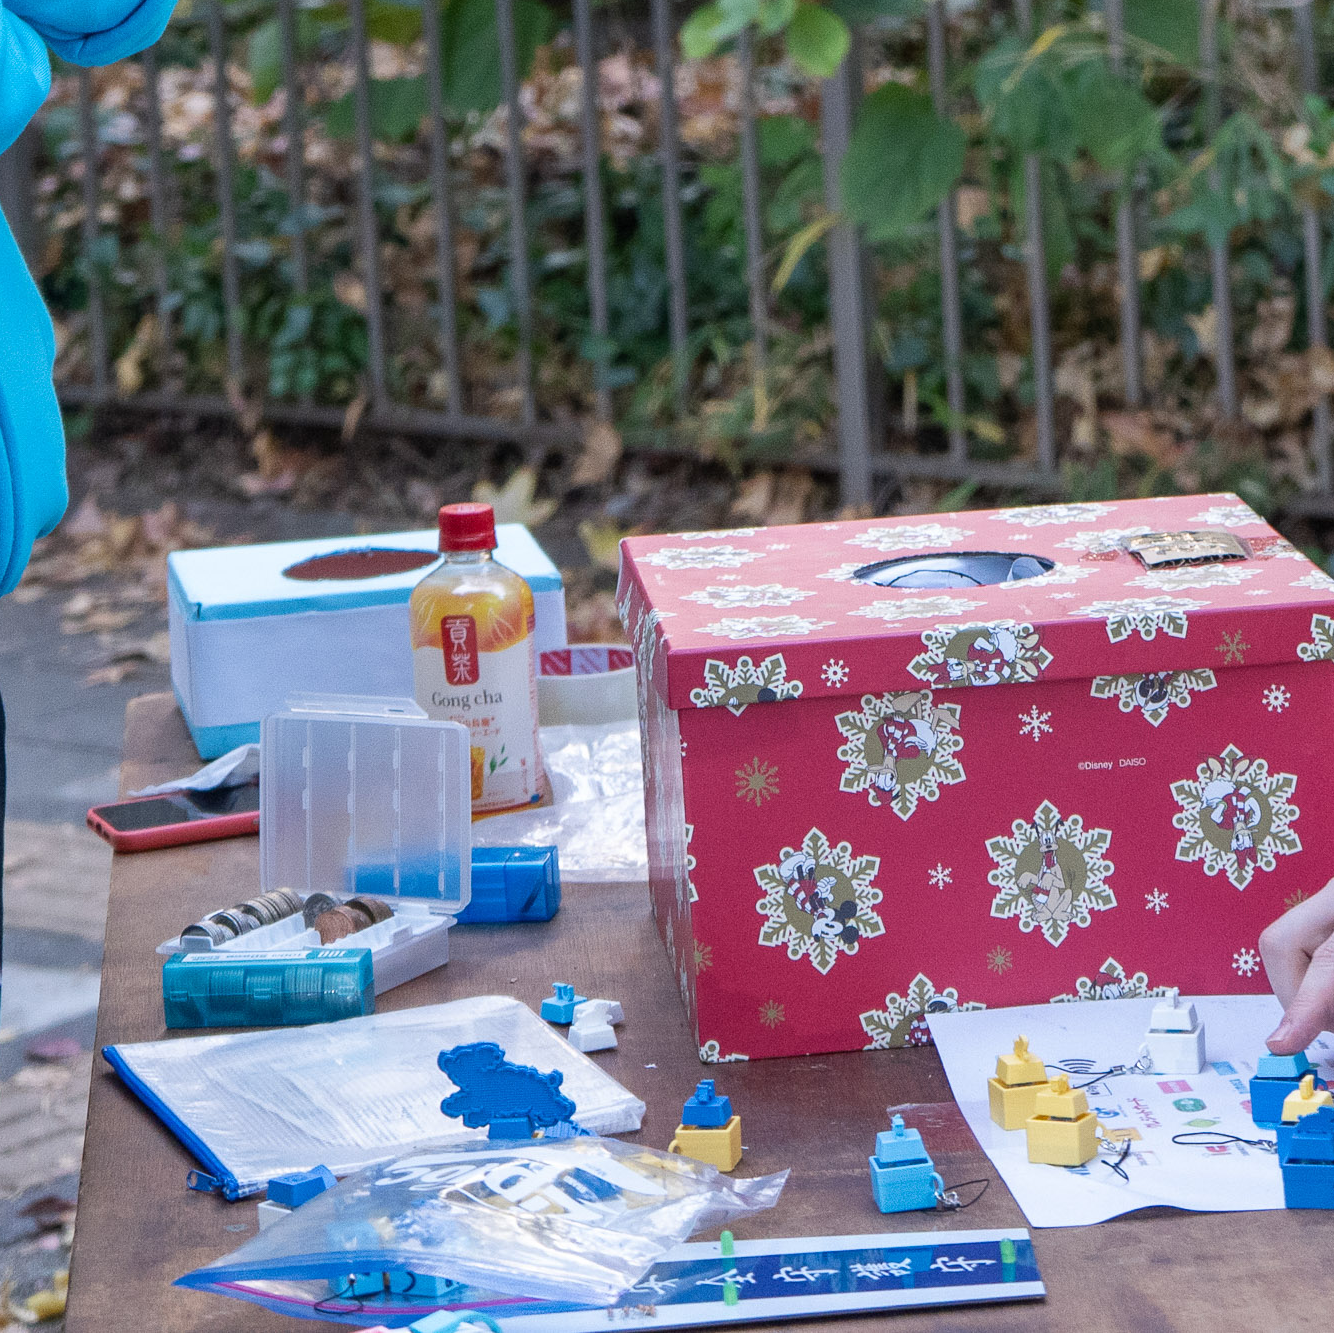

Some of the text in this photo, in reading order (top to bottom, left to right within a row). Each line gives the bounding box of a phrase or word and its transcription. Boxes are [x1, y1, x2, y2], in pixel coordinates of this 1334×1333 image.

[444, 618, 472, 683] 貢茶
[432, 690, 503, 710] Gong cha
[1119, 757, 1146, 767] DAISO
